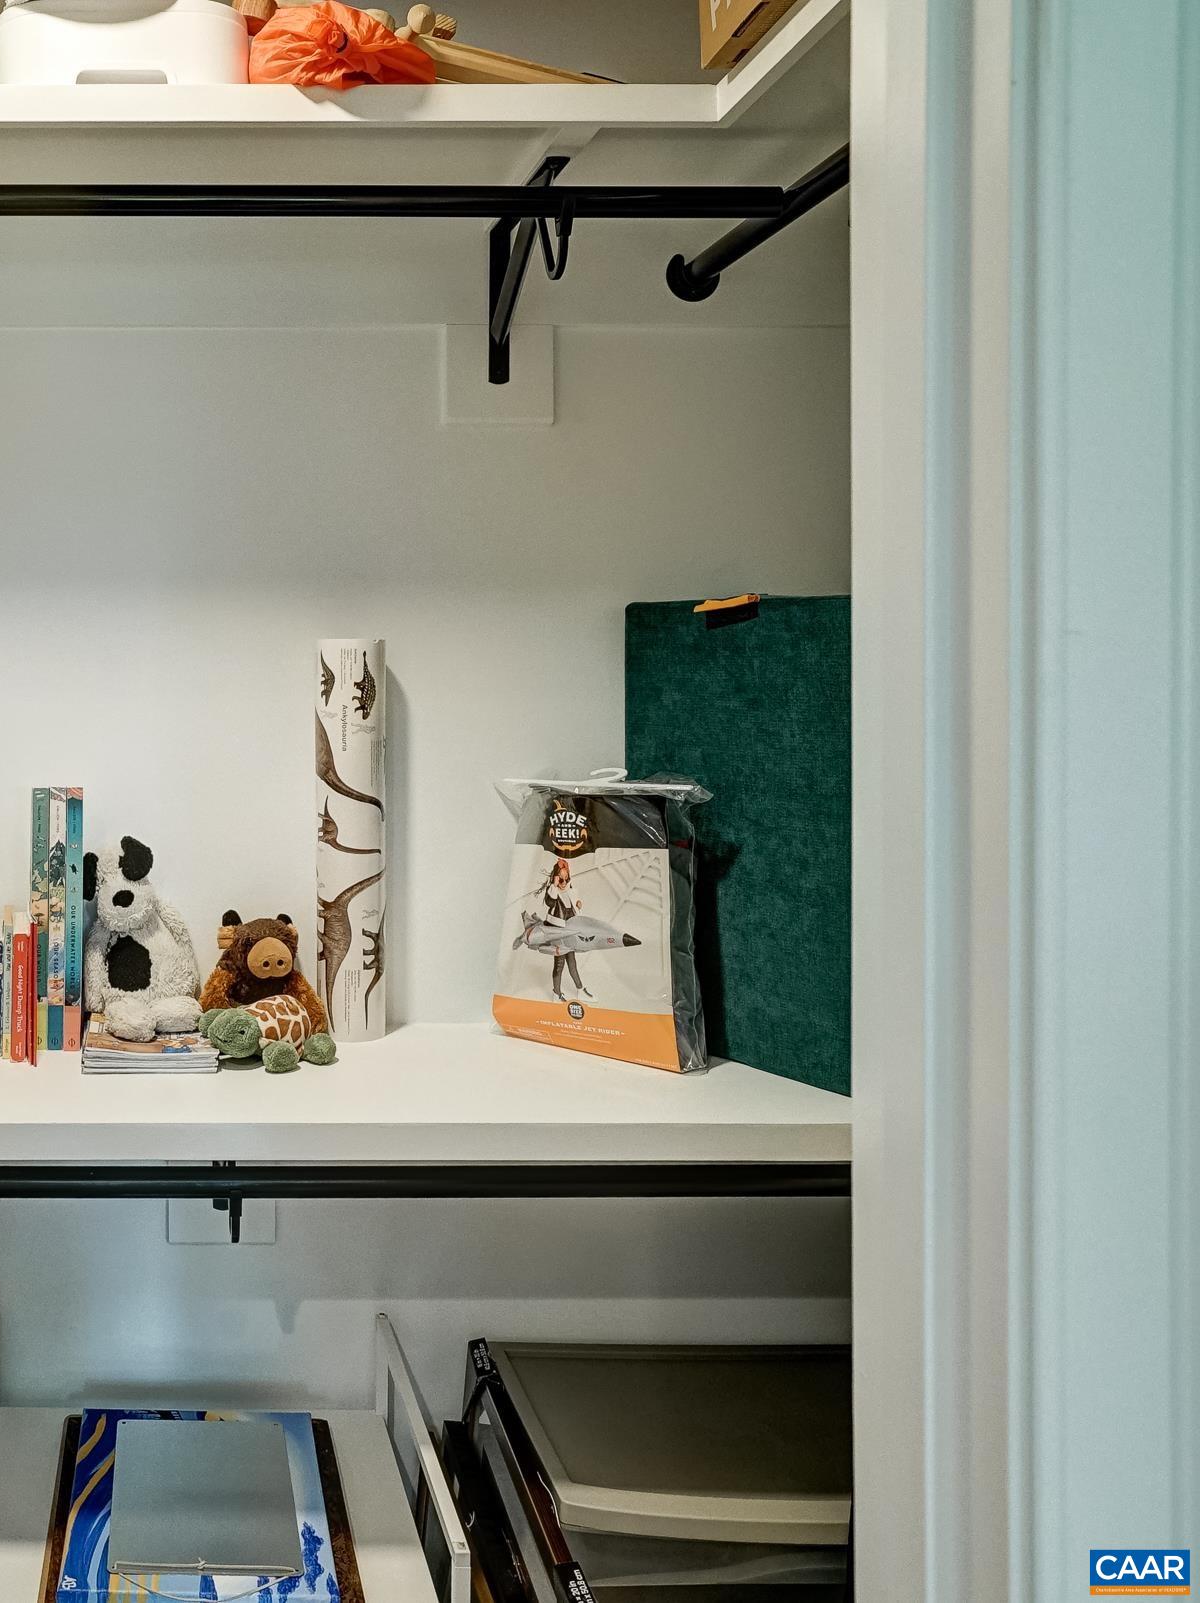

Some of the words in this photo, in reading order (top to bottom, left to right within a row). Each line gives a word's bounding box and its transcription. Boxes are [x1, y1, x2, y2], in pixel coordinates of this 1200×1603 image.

[550, 812, 587, 827] HYDE
[556, 828, 579, 839] EEK!
[574, 1570, 583, 1580] cm
[571, 1588, 581, 1597] 20
[577, 1580, 589, 1595] 50.8
